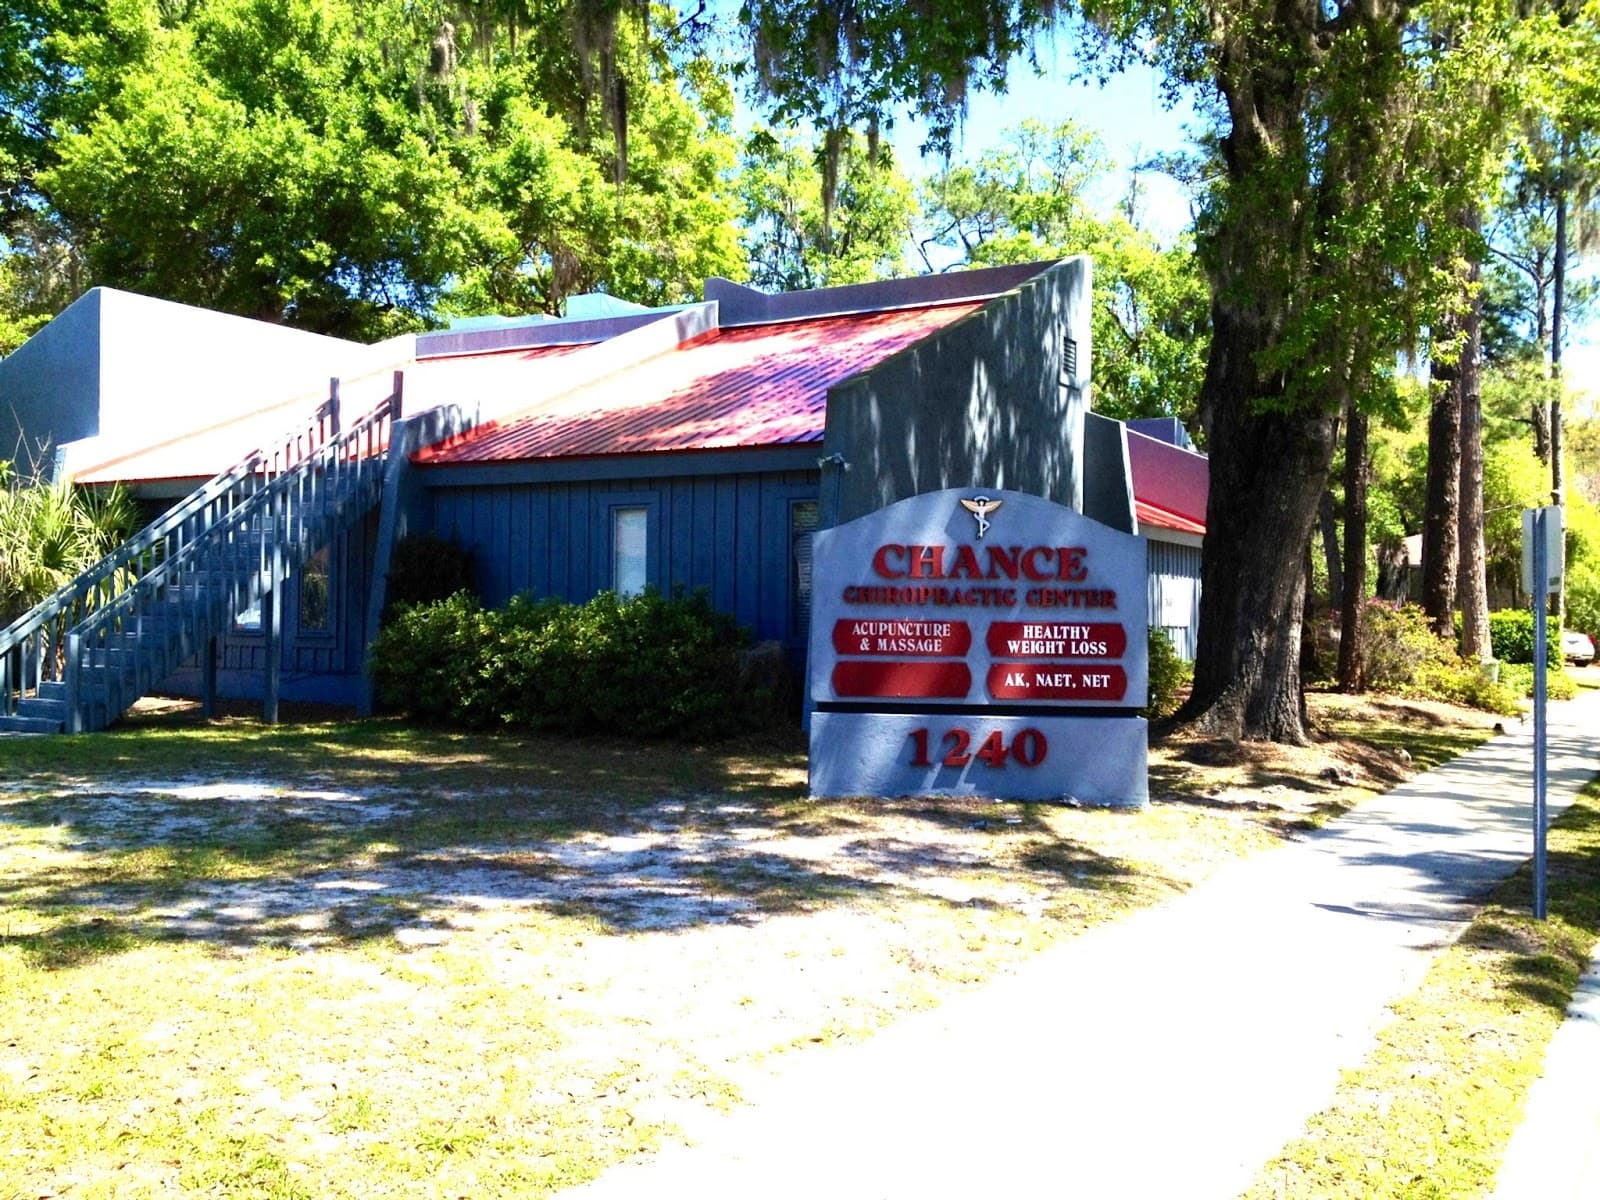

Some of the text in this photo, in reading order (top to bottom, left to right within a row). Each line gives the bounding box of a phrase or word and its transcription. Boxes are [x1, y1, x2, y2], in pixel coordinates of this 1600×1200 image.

[873, 543, 1089, 582] CHANCE
[843, 585, 1118, 610] CHIROPRACTIC CENTER
[852, 621, 951, 637] ACUPUNCTURE
[1023, 625, 1090, 639] HEALTHY
[860, 639, 942, 652] & MASSAGE
[1007, 640, 1107, 655] WEIGHT LOSS
[1005, 673, 1111, 688] AK, NAET, NET
[908, 728, 1048, 768] 1240
